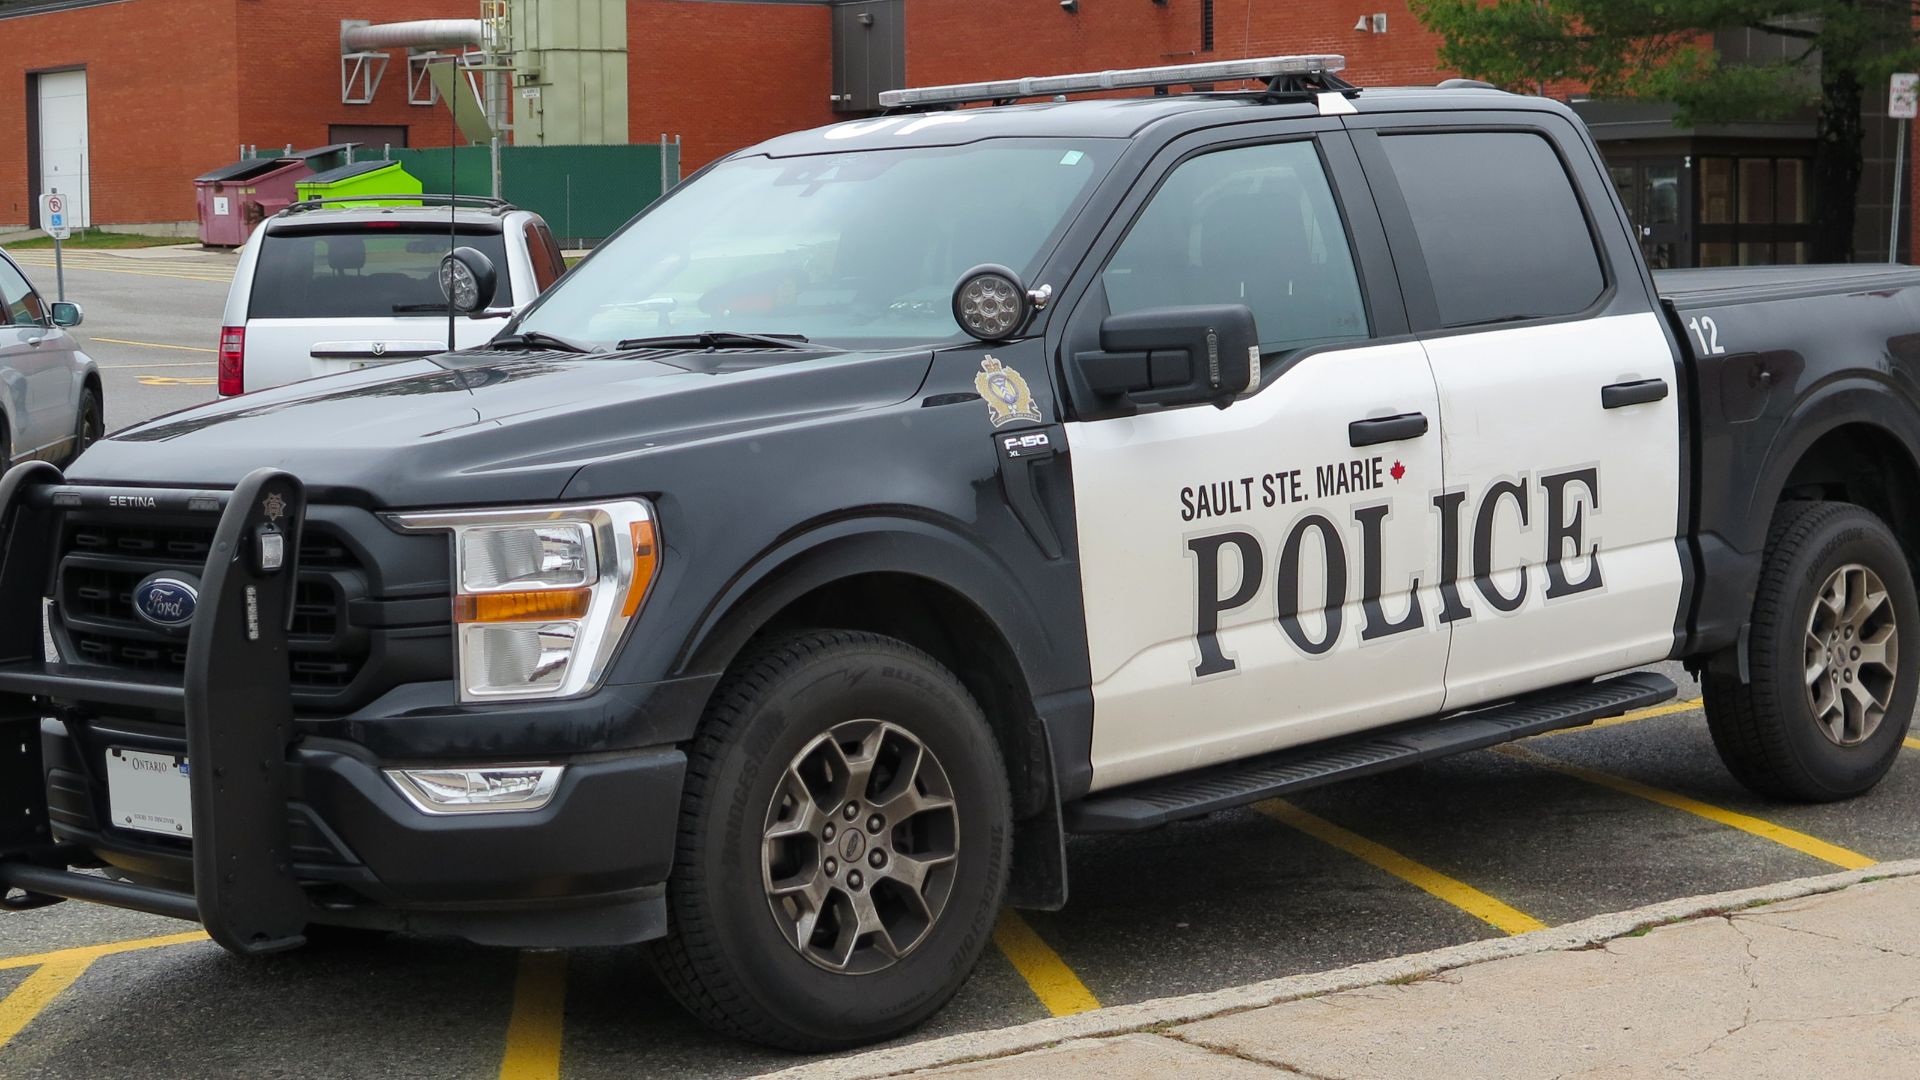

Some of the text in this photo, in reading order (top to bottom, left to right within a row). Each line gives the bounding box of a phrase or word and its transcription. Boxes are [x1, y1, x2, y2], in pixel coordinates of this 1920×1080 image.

[1689, 316, 1725, 355] 12
[1004, 433, 1048, 450] F-150
[109, 495, 156, 508] SETINA
[1180, 456, 1384, 522] SAULT STE. MARIE
[1187, 466, 1604, 678] POLICE
[146, 588, 183, 617] Ford
[132, 757, 167, 773] ONTARIO
